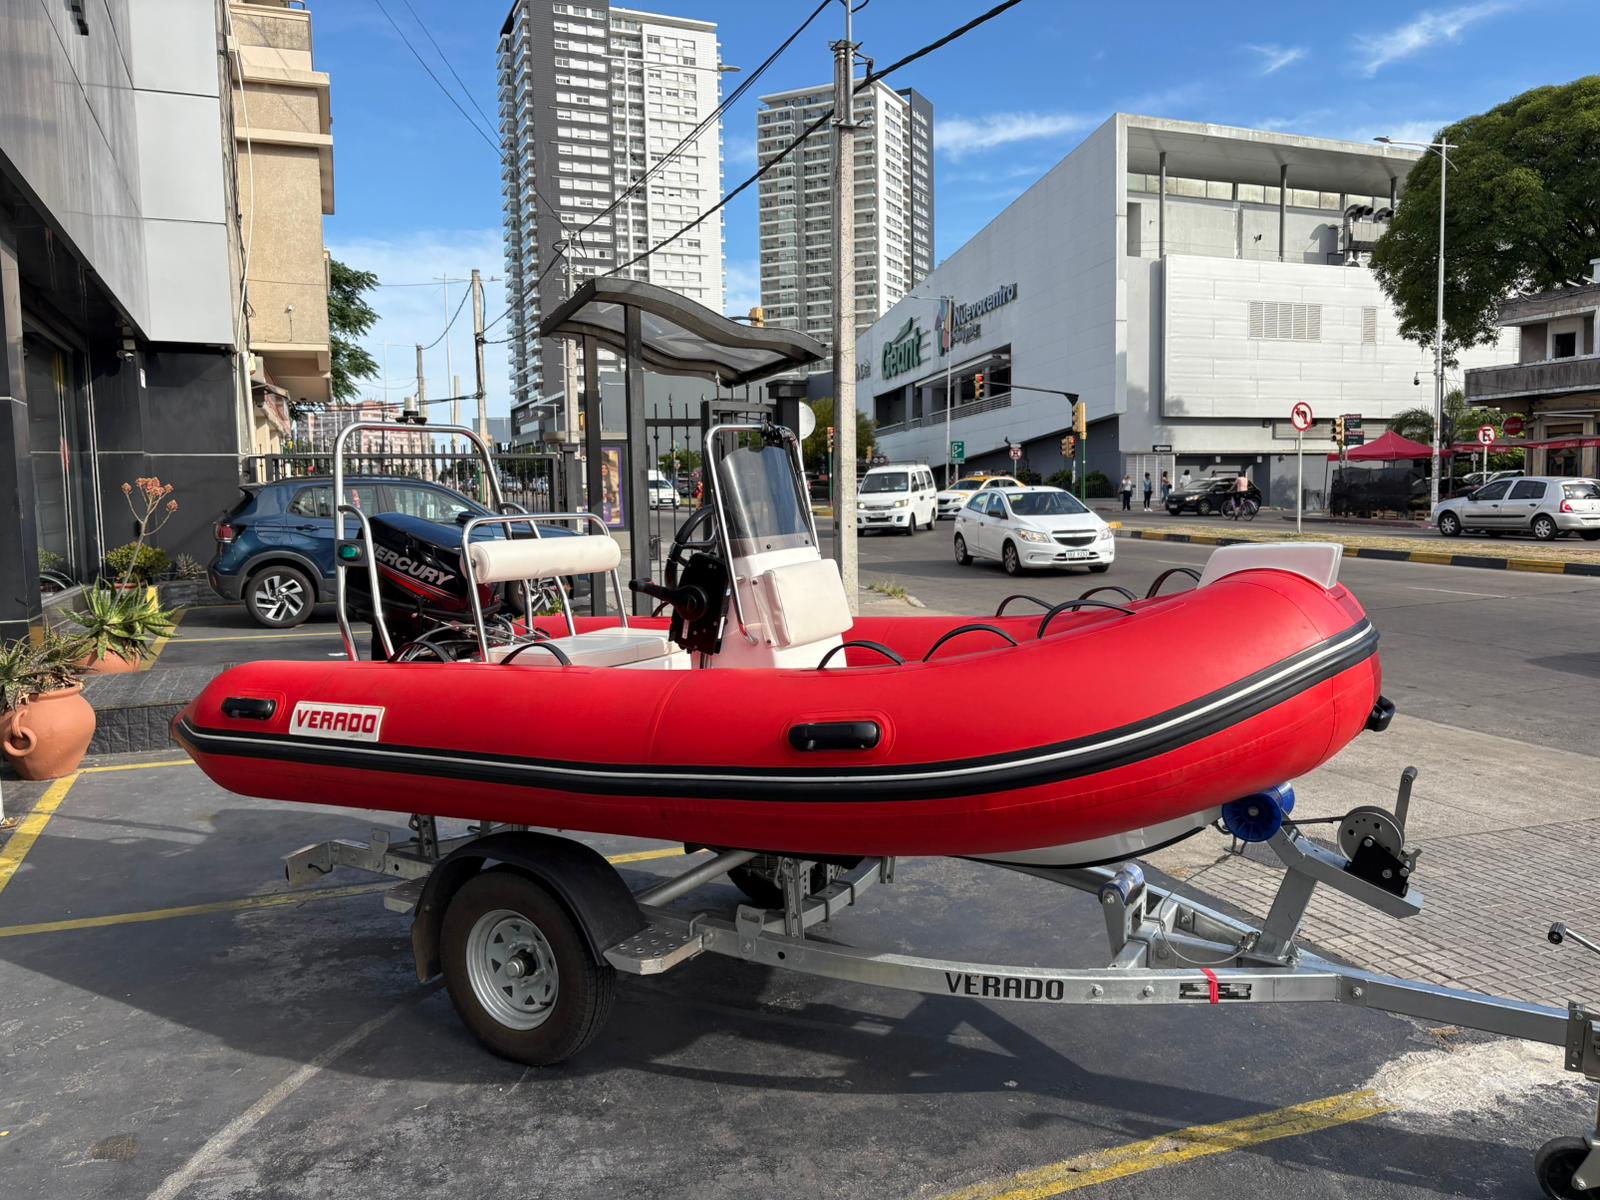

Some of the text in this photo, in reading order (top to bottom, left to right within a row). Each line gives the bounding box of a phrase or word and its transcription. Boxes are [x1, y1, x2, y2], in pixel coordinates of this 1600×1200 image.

[954, 283, 1017, 326] Nuevocentro
[373, 543, 455, 585] ERCURY
[296, 709, 377, 733] VERADO
[945, 972, 1064, 1000] VERADO
